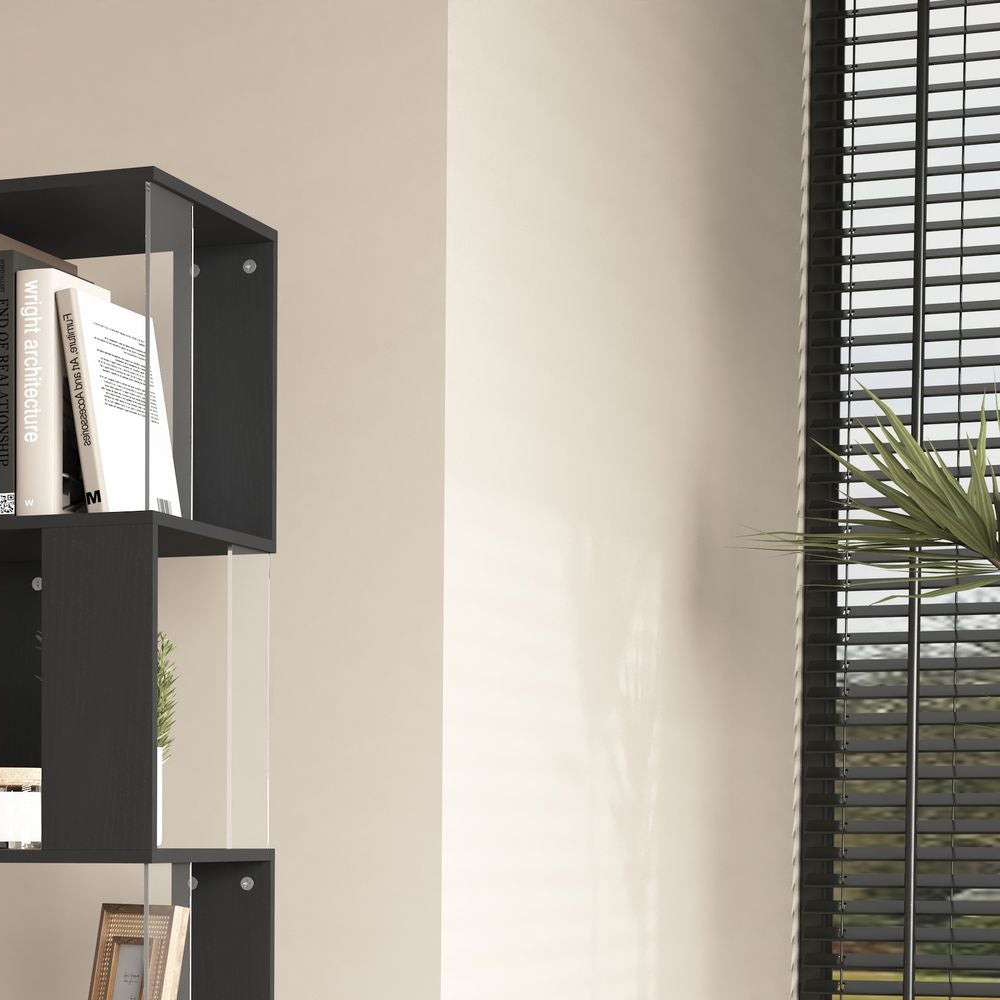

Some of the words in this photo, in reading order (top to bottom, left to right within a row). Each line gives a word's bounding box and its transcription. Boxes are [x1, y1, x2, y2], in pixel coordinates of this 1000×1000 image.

[20, 280, 43, 334] wright
[23, 340, 42, 443] architecture
[86, 490, 102, 505] M
